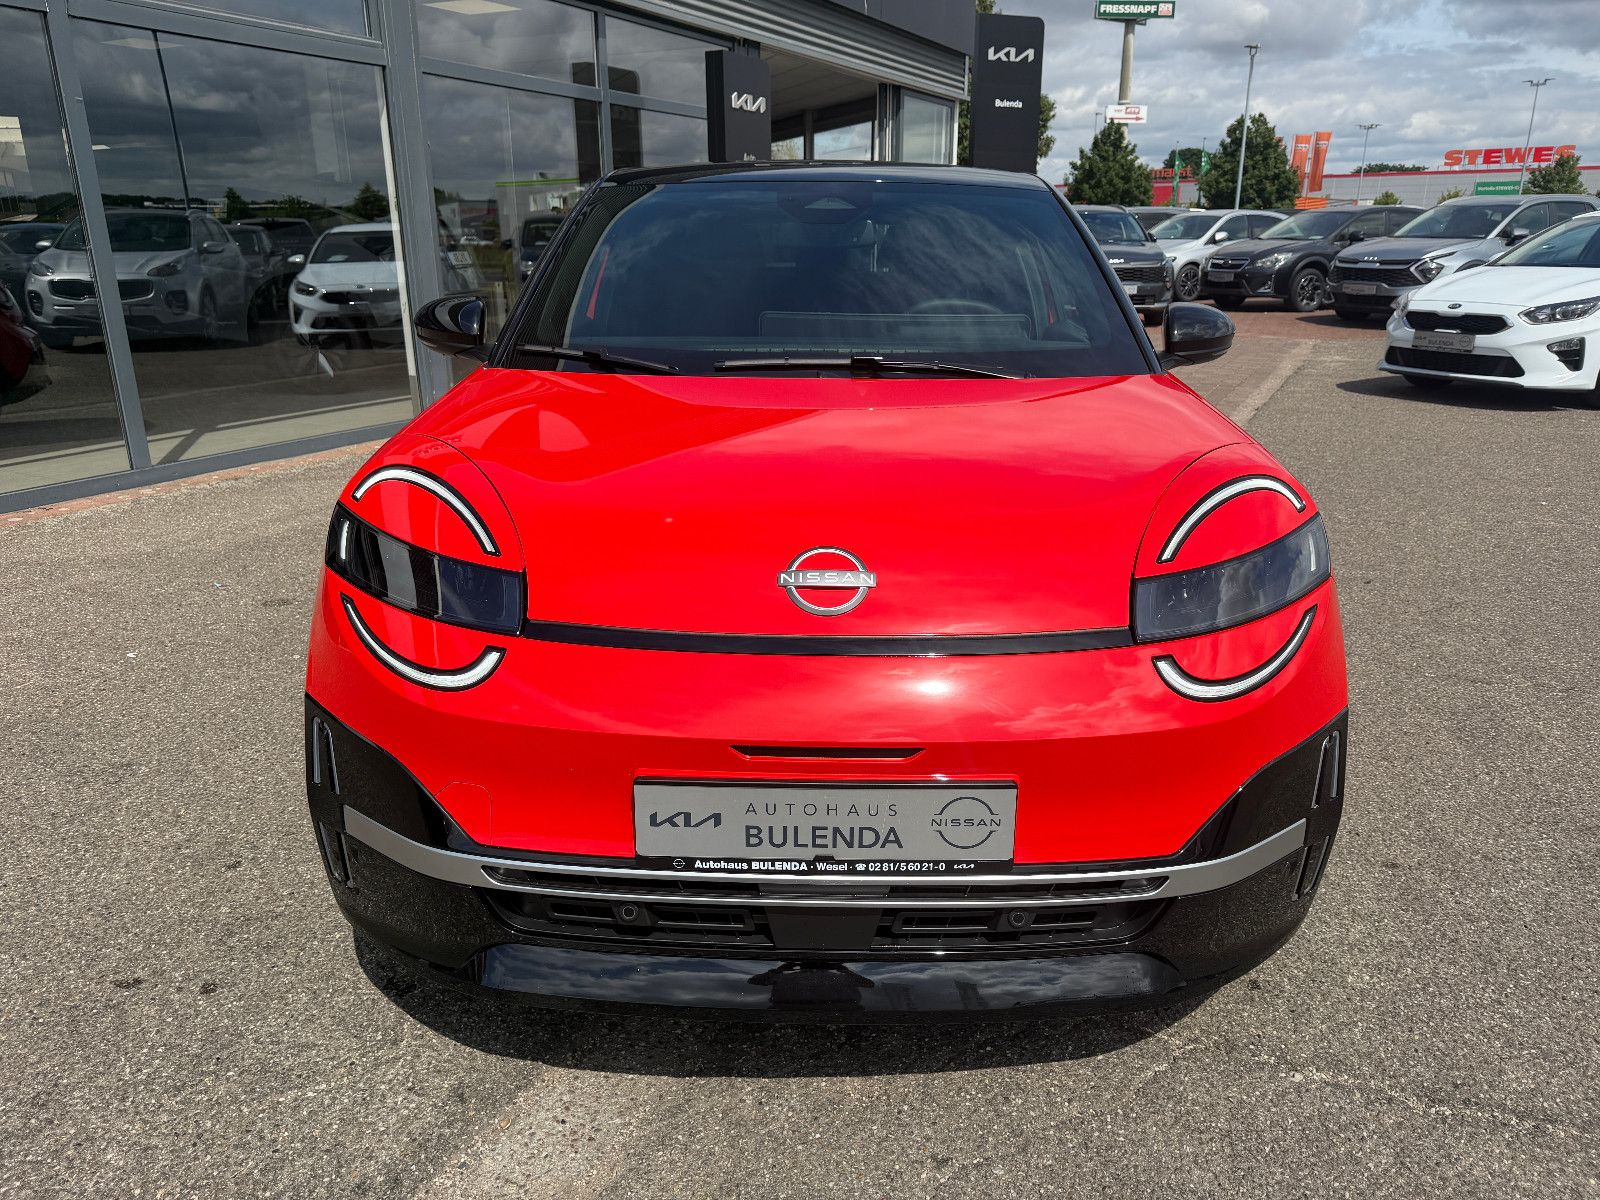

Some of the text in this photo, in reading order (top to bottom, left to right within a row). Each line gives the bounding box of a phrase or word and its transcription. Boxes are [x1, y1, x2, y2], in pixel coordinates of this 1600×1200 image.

[1100, 3, 1158, 14] FRESSNAPF
[987, 45, 1035, 63] KIA
[731, 91, 767, 114] KIA
[994, 98, 1023, 109] Bulenda
[1443, 145, 1577, 166] STEWES
[780, 571, 875, 584] NISSAN
[745, 802, 898, 817] AUTOHAUS
[649, 811, 722, 828] KIA
[931, 818, 1002, 827] NISSAN
[745, 825, 904, 849] BULENDA
[694, 860, 749, 870] Autohaus
[751, 861, 808, 871] BULENDA
[816, 862, 848, 871] Wesel
